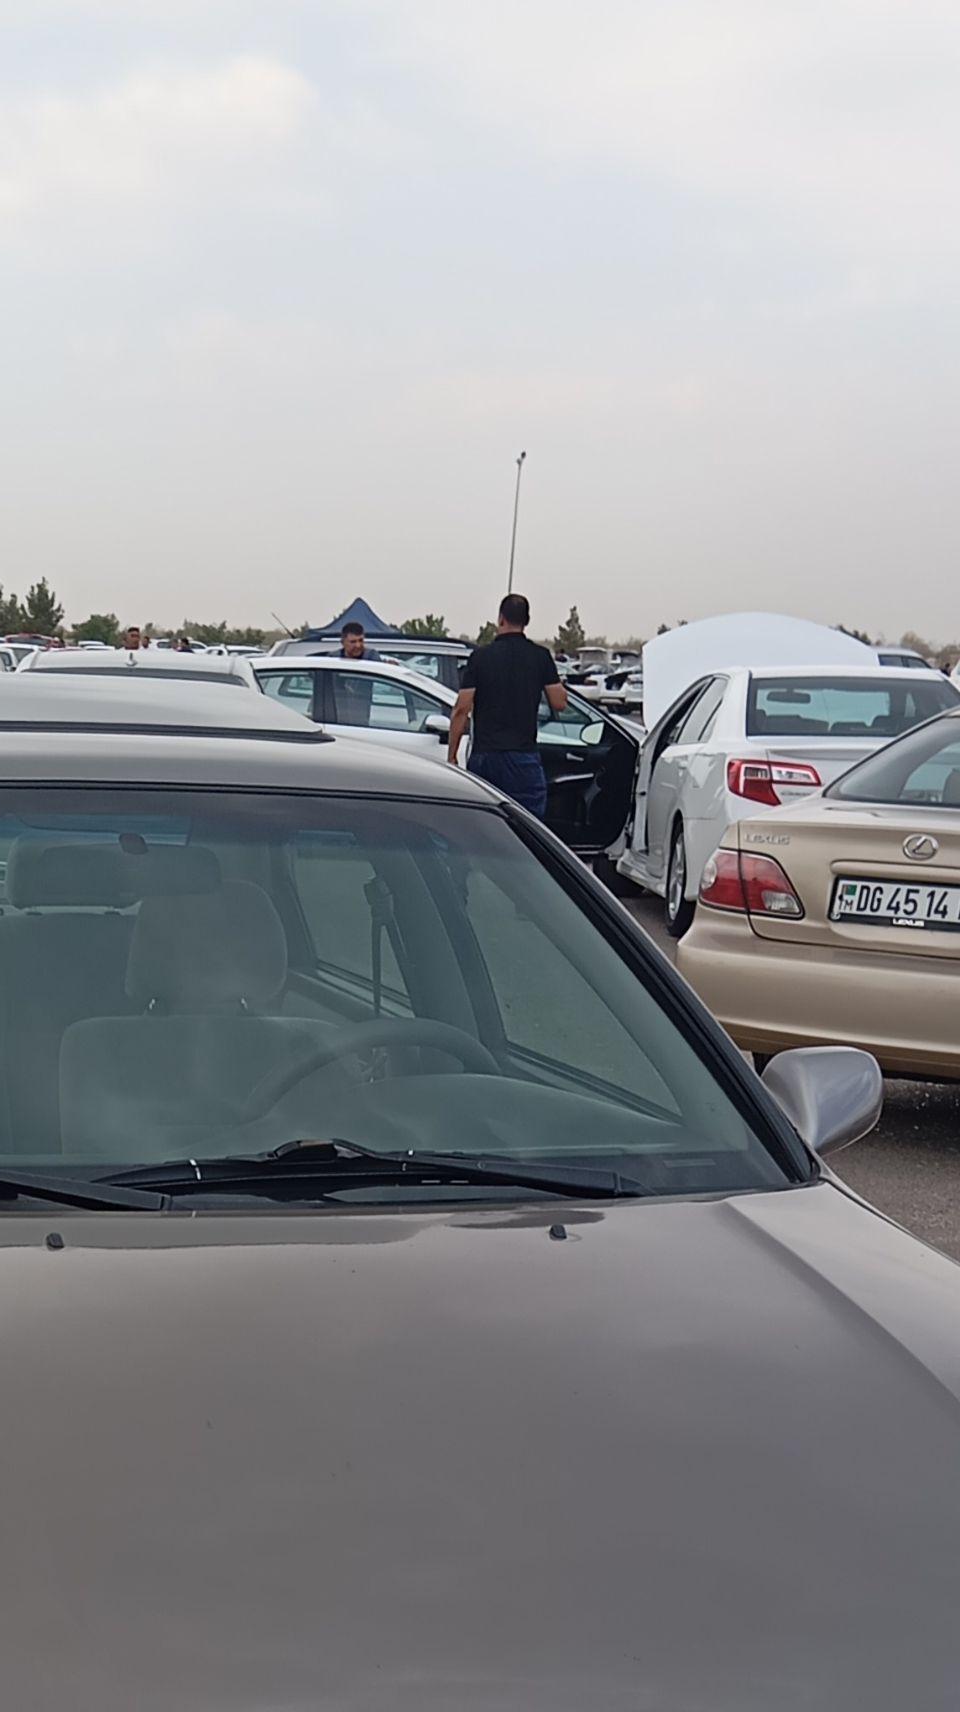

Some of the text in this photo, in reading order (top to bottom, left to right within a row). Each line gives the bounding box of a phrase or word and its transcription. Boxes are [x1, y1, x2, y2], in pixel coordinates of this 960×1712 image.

[856, 884, 949, 919] DG 45 14
